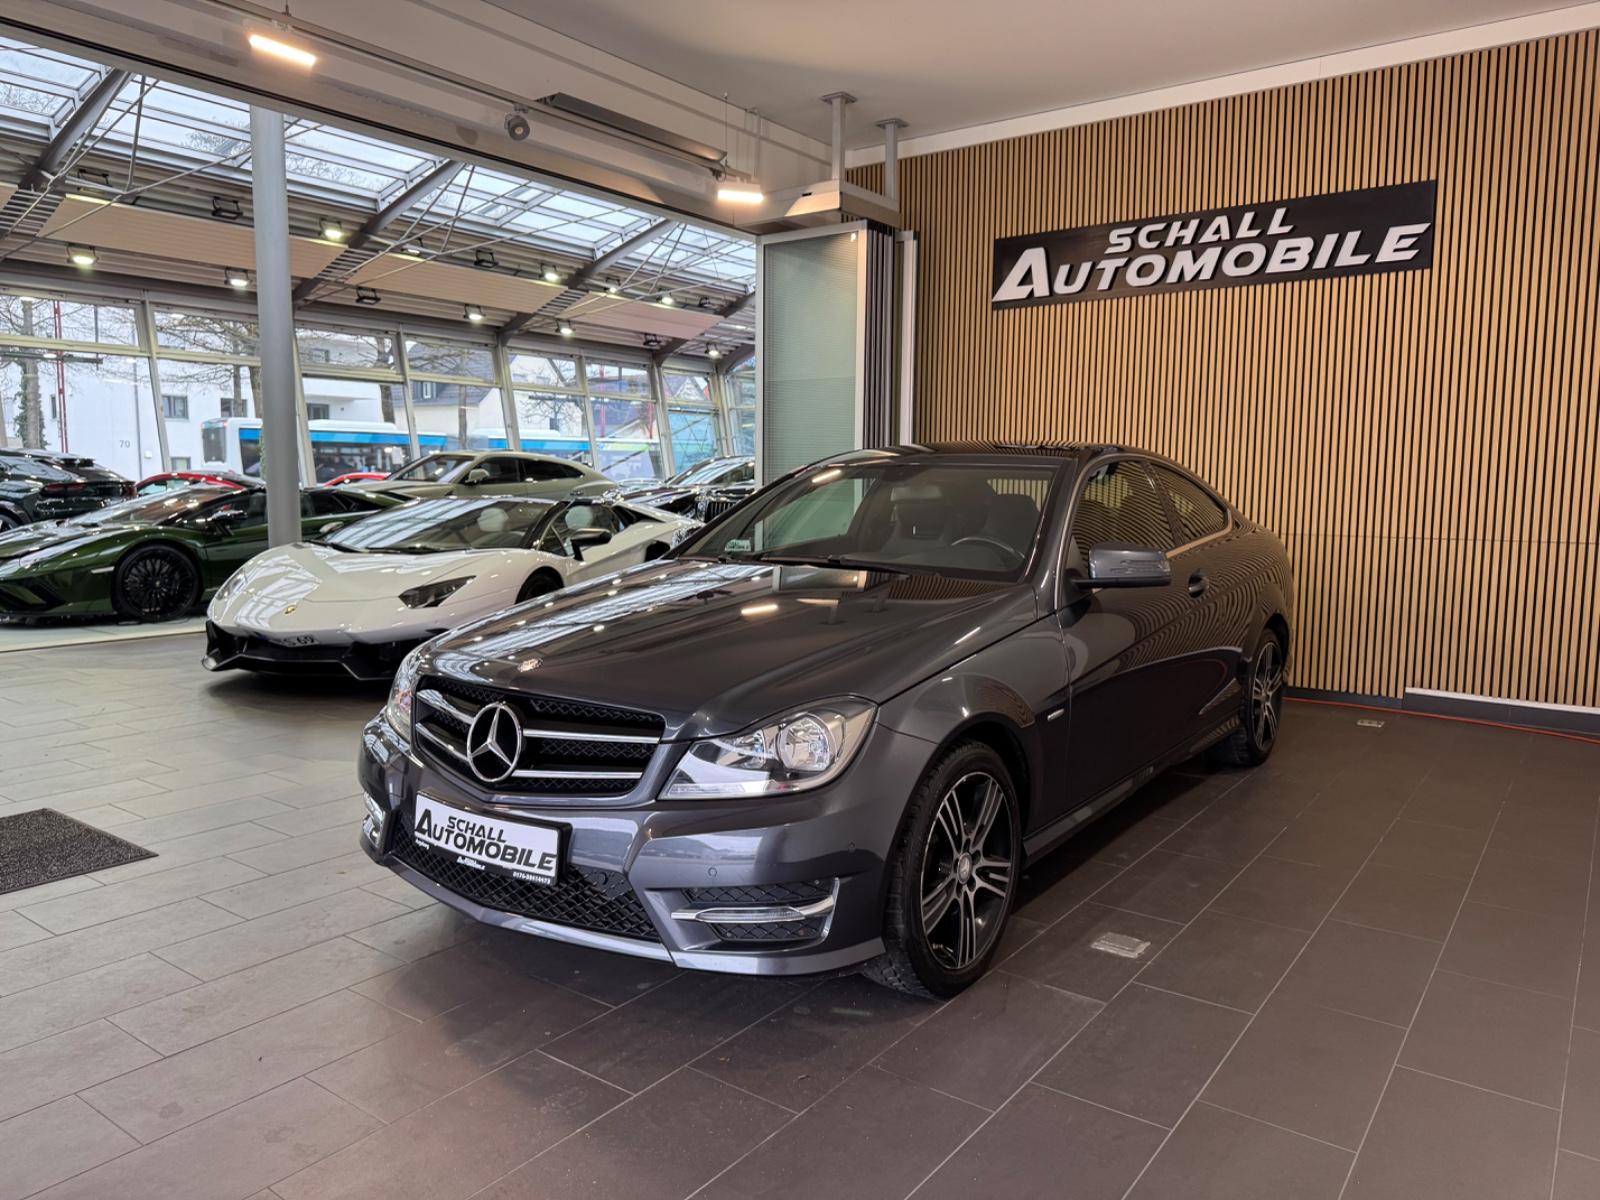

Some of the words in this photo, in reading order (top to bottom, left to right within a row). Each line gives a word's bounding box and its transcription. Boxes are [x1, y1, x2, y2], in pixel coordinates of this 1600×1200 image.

[1105, 207, 1295, 255] SCHALL
[991, 222, 1431, 303] AUTOMOBILE
[119, 439, 131, 449] 70
[414, 808, 557, 871] AUTOMOBILE
[447, 816, 506, 843] SCHALL
